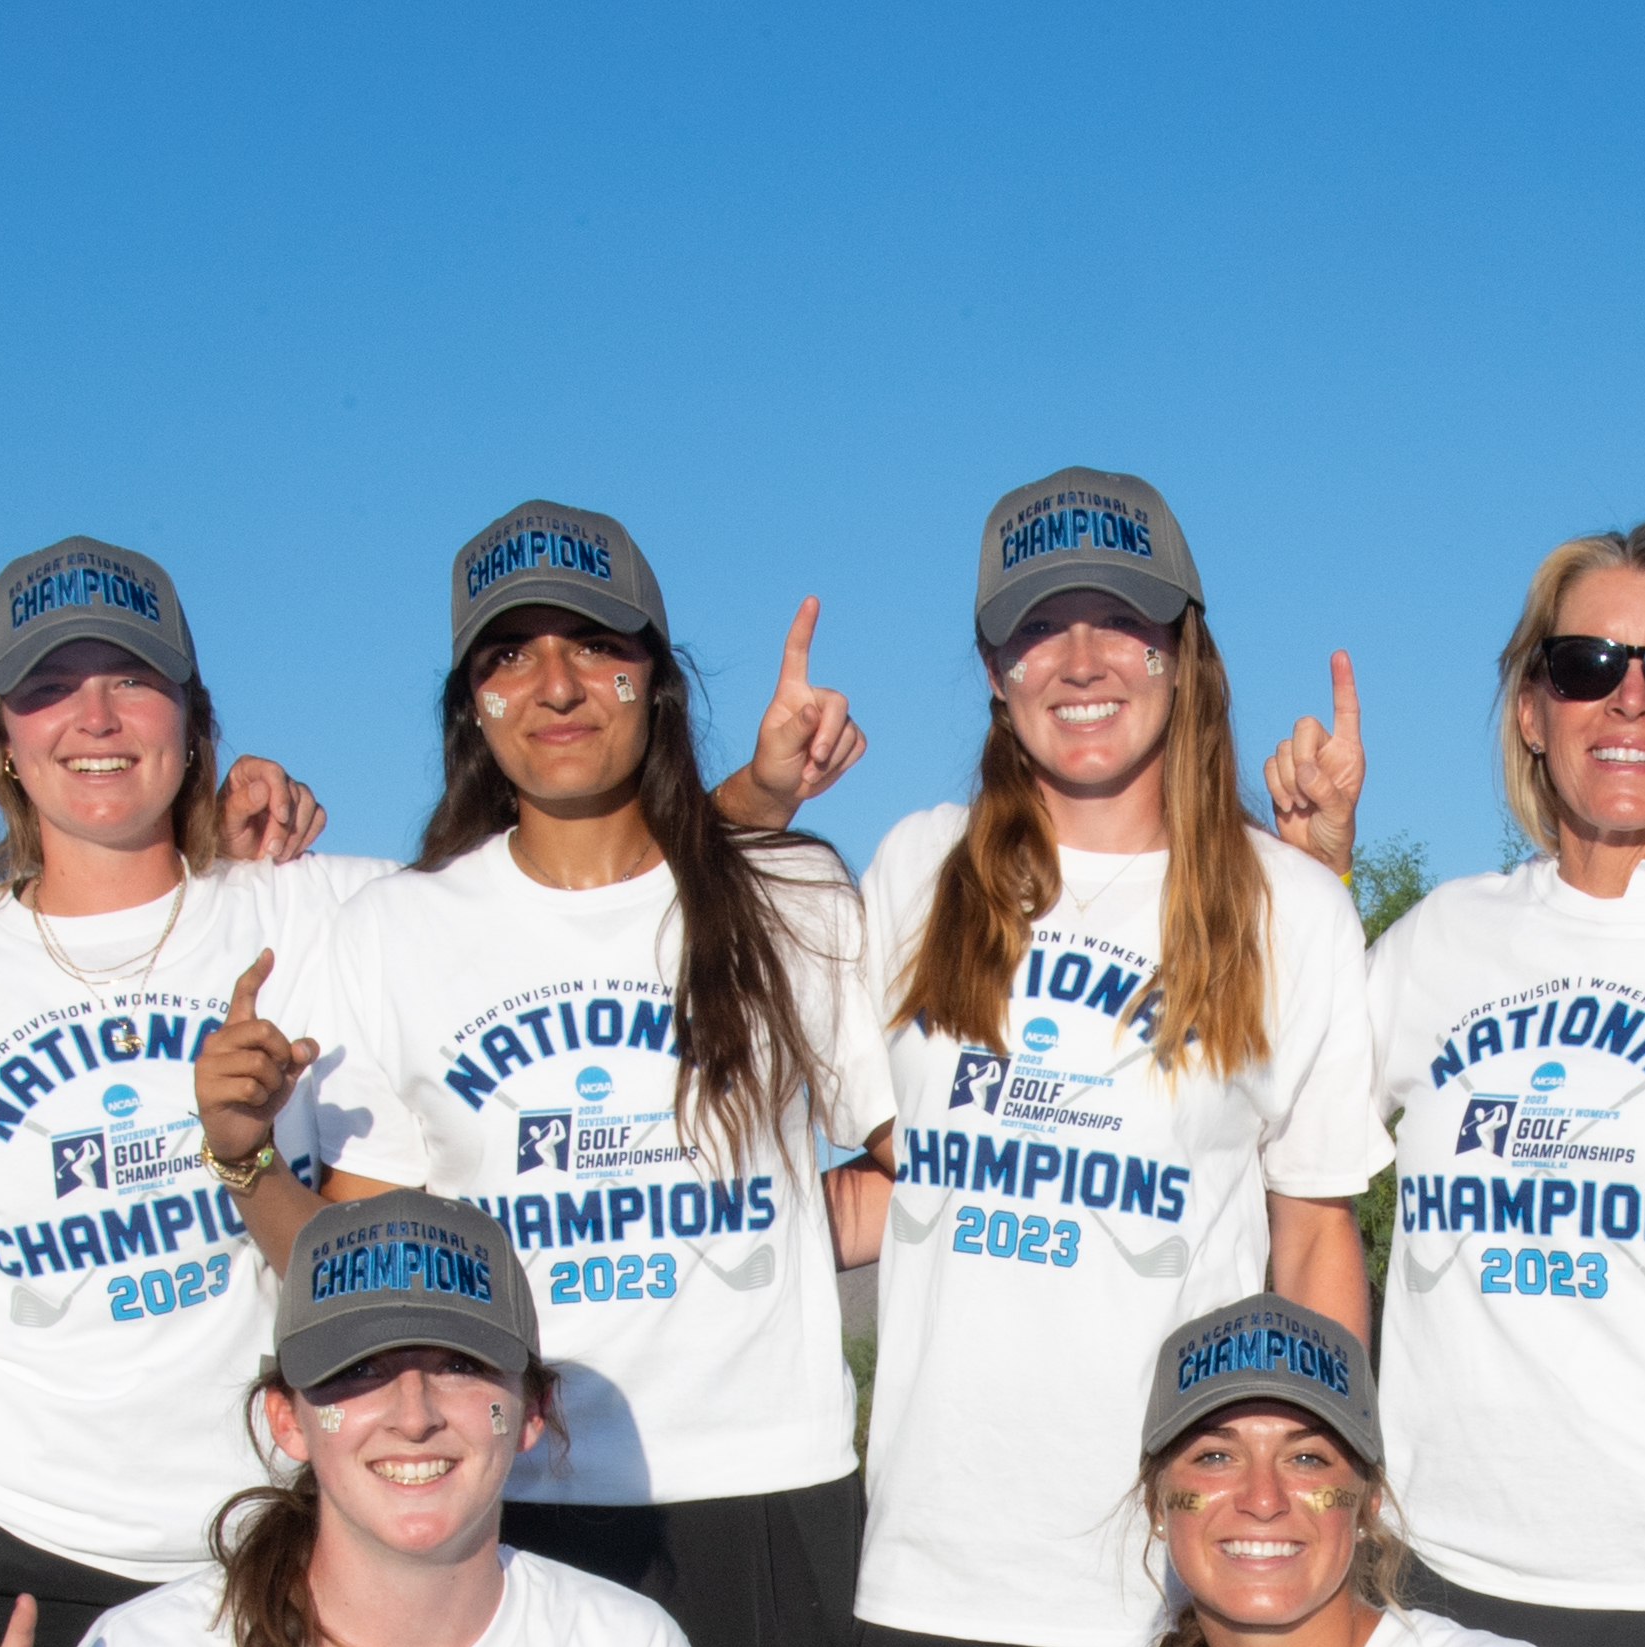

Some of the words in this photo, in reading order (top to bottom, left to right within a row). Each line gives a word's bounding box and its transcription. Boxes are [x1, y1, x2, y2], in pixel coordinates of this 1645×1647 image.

[1003, 508, 1153, 572] CHAMPIONS
[467, 531, 612, 601] CHAMPIONS
[11, 568, 161, 631] CHAMPIONS
[1500, 977, 1570, 1008] DIVISION
[13, 1001, 93, 1041] DIVISION
[114, 993, 201, 1011] WOMEN'S
[207, 997, 230, 1015] GO
[454, 1006, 498, 1044] NCAA
[503, 980, 583, 1011] DIVISION
[606, 979, 673, 997] WOMEN
[1025, 1032, 1057, 1045] NCAA
[444, 998, 681, 1113] NATION
[1017, 1054, 1043, 1065] 2023
[579, 1082, 612, 1093] NCAA
[1009, 1077, 1064, 1104] GOLF
[1014, 1066, 1059, 1080] DIVISION
[1069, 1073, 1114, 1087] WOMEN'S
[578, 1105, 603, 1116] 2023
[1003, 1102, 1123, 1131] CHAMPIONSHIPS
[1521, 1107, 1565, 1117] DIVISION
[1575, 1108, 1620, 1120] WOMEN'S
[110, 1120, 134, 1133] 2023
[578, 1126, 631, 1151] GOLF
[1516, 1118, 1571, 1141] GOLF
[114, 1136, 166, 1167] GOLF
[576, 1146, 698, 1169] CHAMPIONSHIPS
[1512, 1143, 1636, 1164] CHAMPIONSHIPS
[116, 1153, 203, 1185] CHAMPIONS
[953, 1205, 1081, 1268] 2023
[107, 1253, 230, 1321] 2023
[312, 1240, 491, 1304] CHAMPIONS
[551, 1253, 676, 1305] 2023
[1481, 1248, 1608, 1299] 2023
[1178, 1328, 1349, 1399] CHAMPIONS
